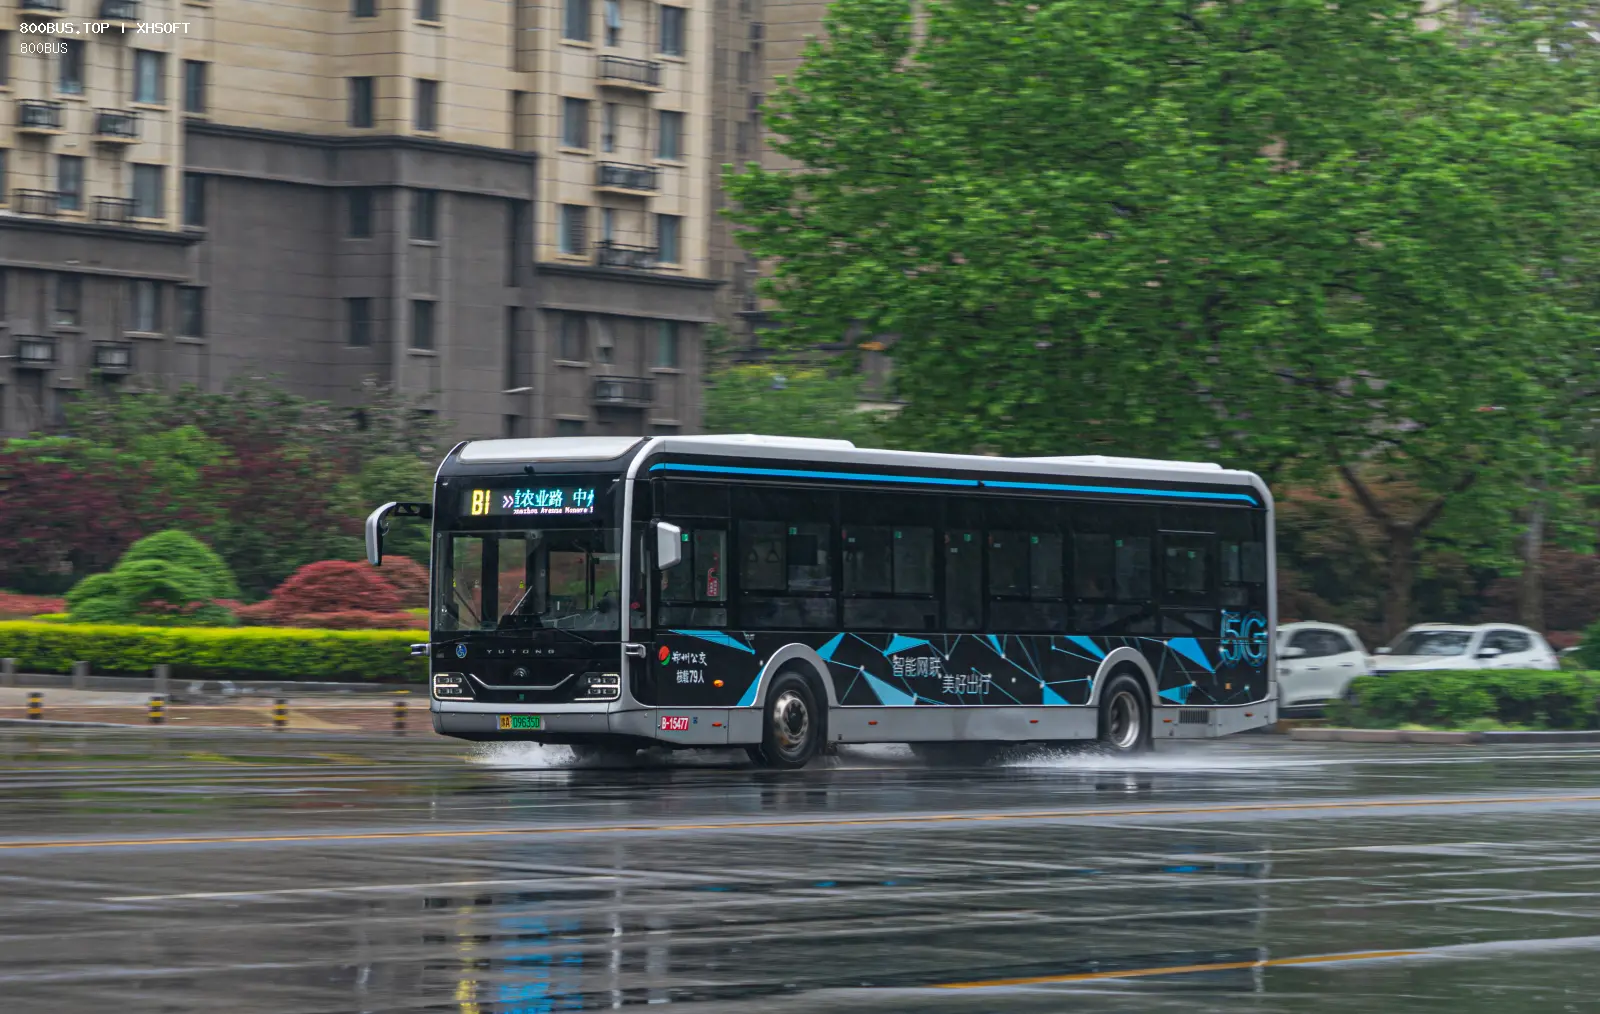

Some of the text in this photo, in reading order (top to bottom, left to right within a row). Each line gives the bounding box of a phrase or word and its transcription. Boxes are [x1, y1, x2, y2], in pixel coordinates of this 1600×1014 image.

[1219, 609, 1268, 668] 5G
[672, 651, 707, 666] 郑州公交
[893, 656, 941, 677] 智能网联
[942, 674, 990, 695] 美好出行
[661, 717, 688, 730] B-15477
